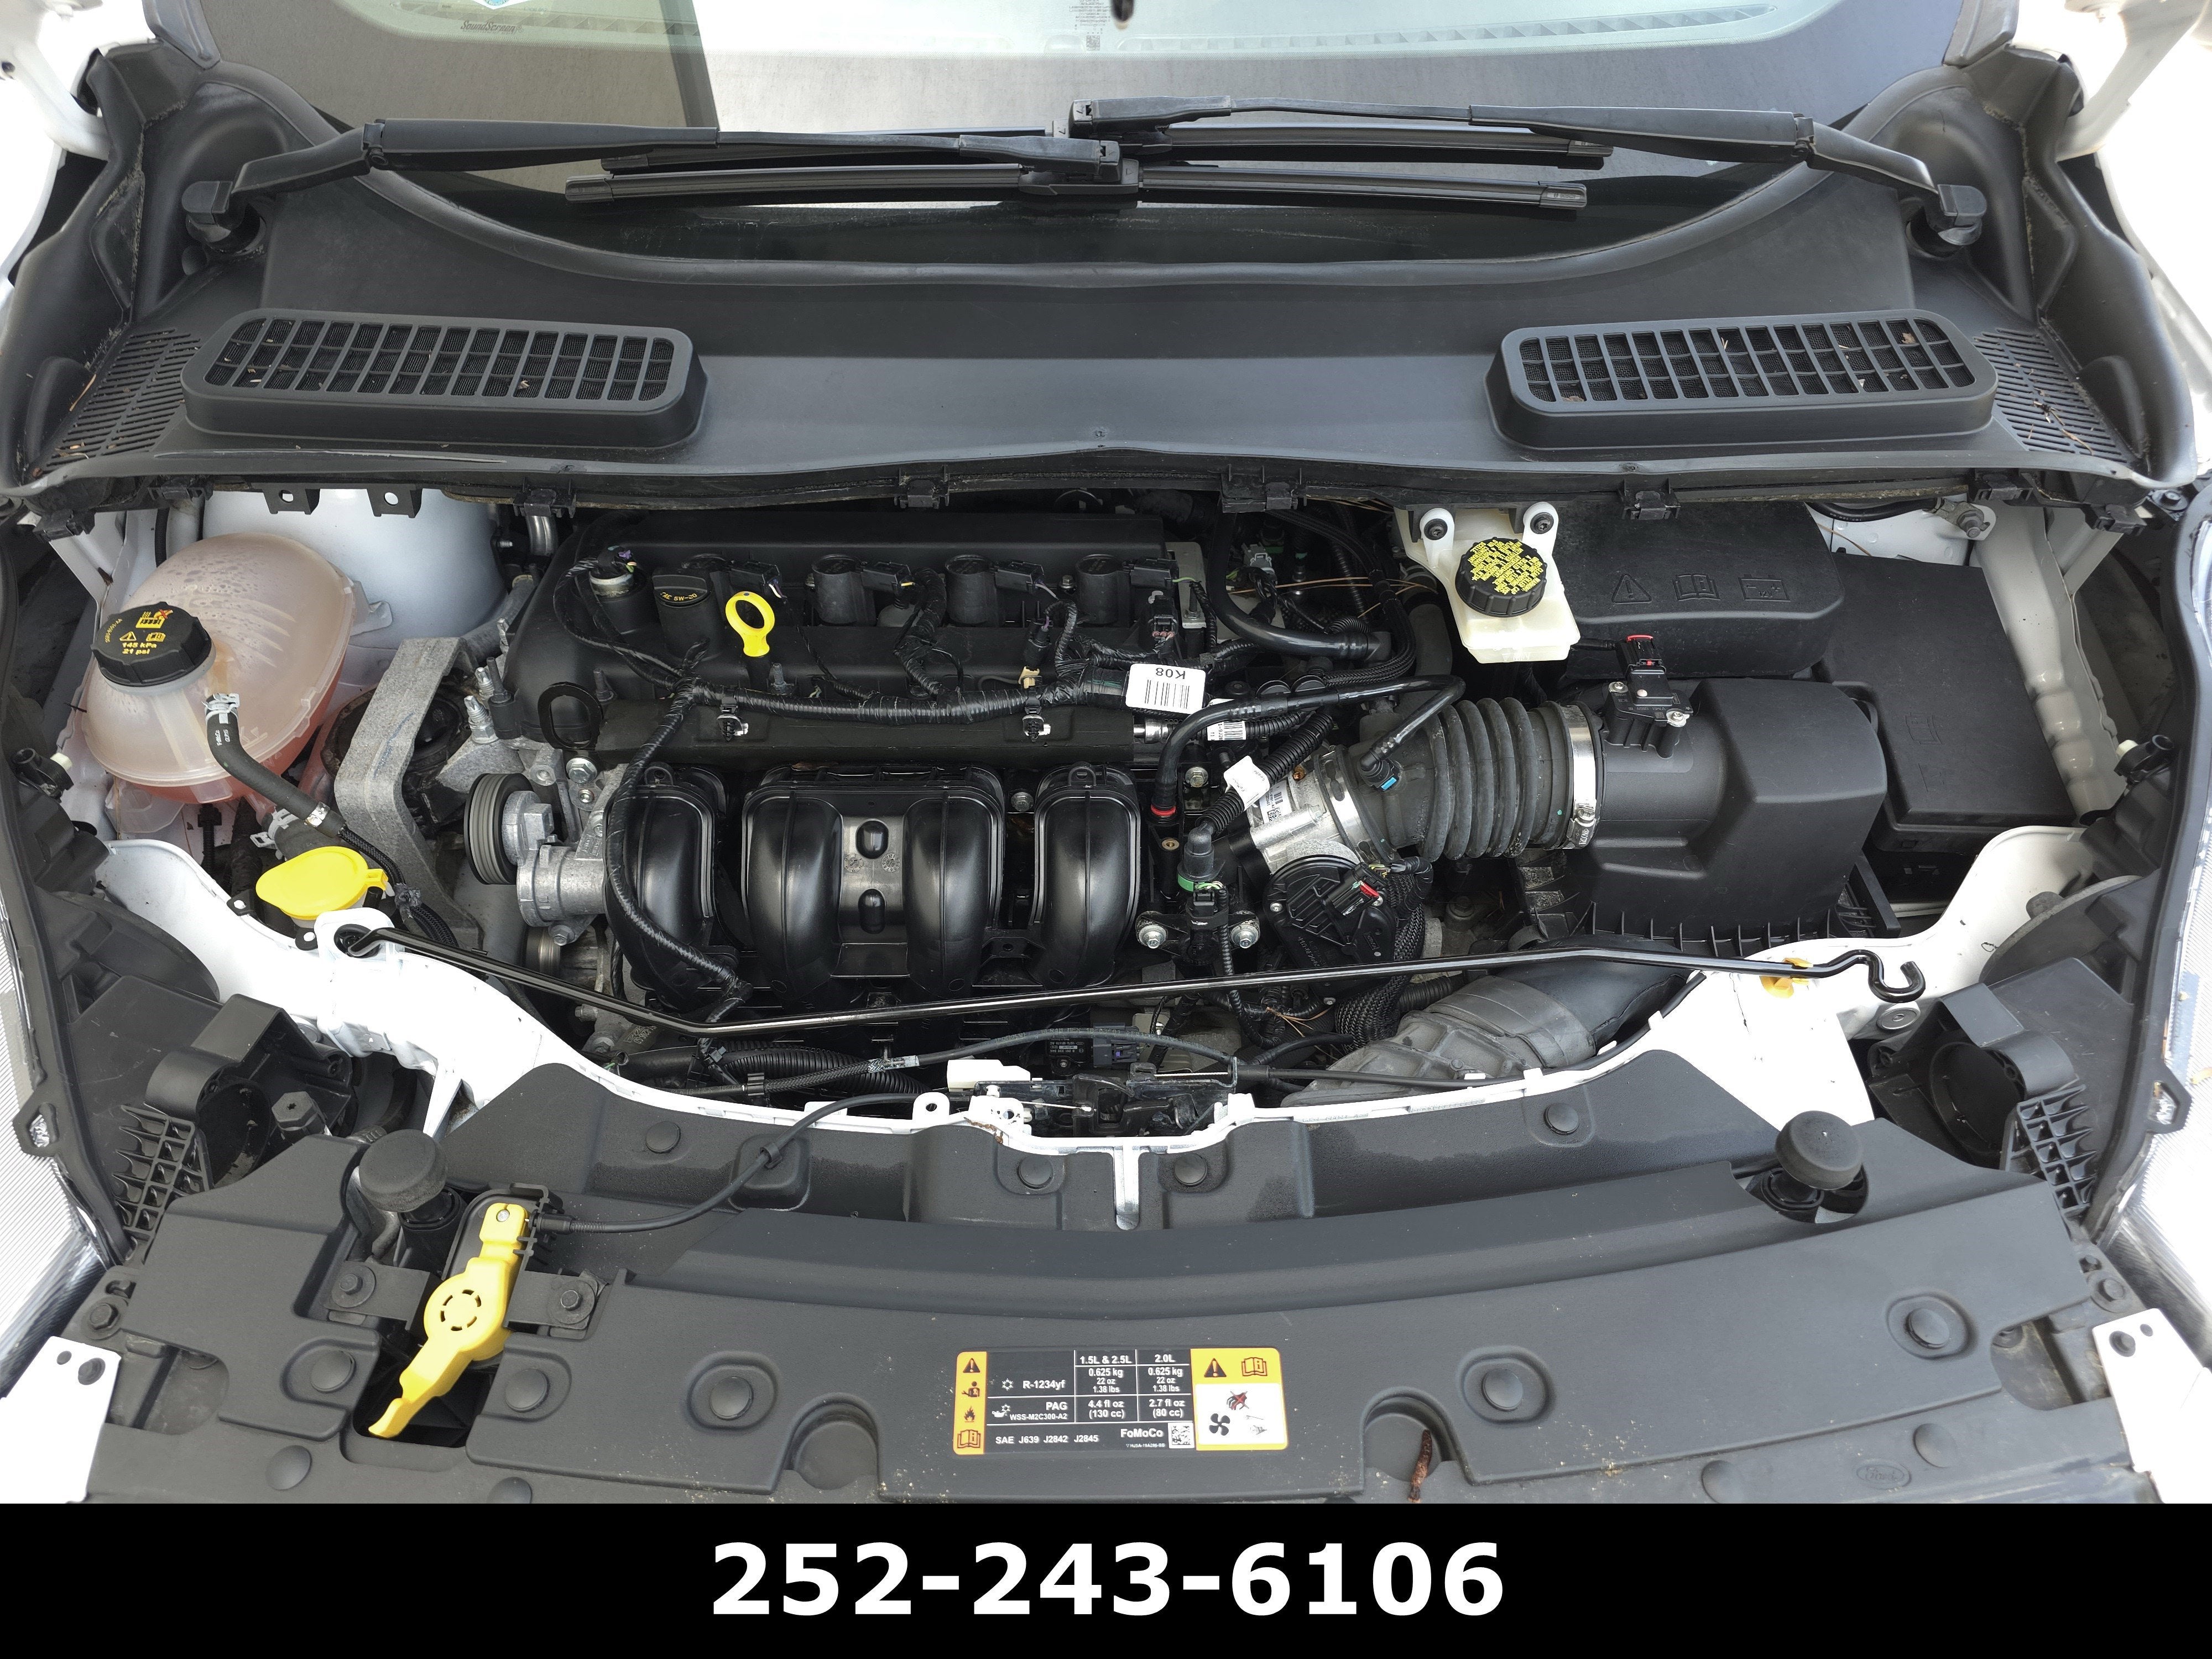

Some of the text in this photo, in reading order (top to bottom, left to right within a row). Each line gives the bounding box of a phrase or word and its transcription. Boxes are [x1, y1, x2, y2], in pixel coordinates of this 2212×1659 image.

[1156, 668, 1185, 679] K08
[1112, 1355, 1133, 1364] 2.5L
[1154, 1354, 1176, 1363] 2.0L
[1088, 1368, 1123, 1378] 0.625 kg
[1147, 1367, 1183, 1377] 0.625 kg
[1022, 1380, 1066, 1391] R-1234yf
[1046, 1402, 1068, 1411] PAG
[1149, 1399, 1162, 1407] 2.7
[1089, 1409, 1125, 1420] (130 cc)
[1152, 1408, 1184, 1418] (80 cc)
[1120, 1428, 1165, 1438] FoMoCo
[995, 1436, 1014, 1444] SAE
[1074, 1434, 1099, 1443] J2845
